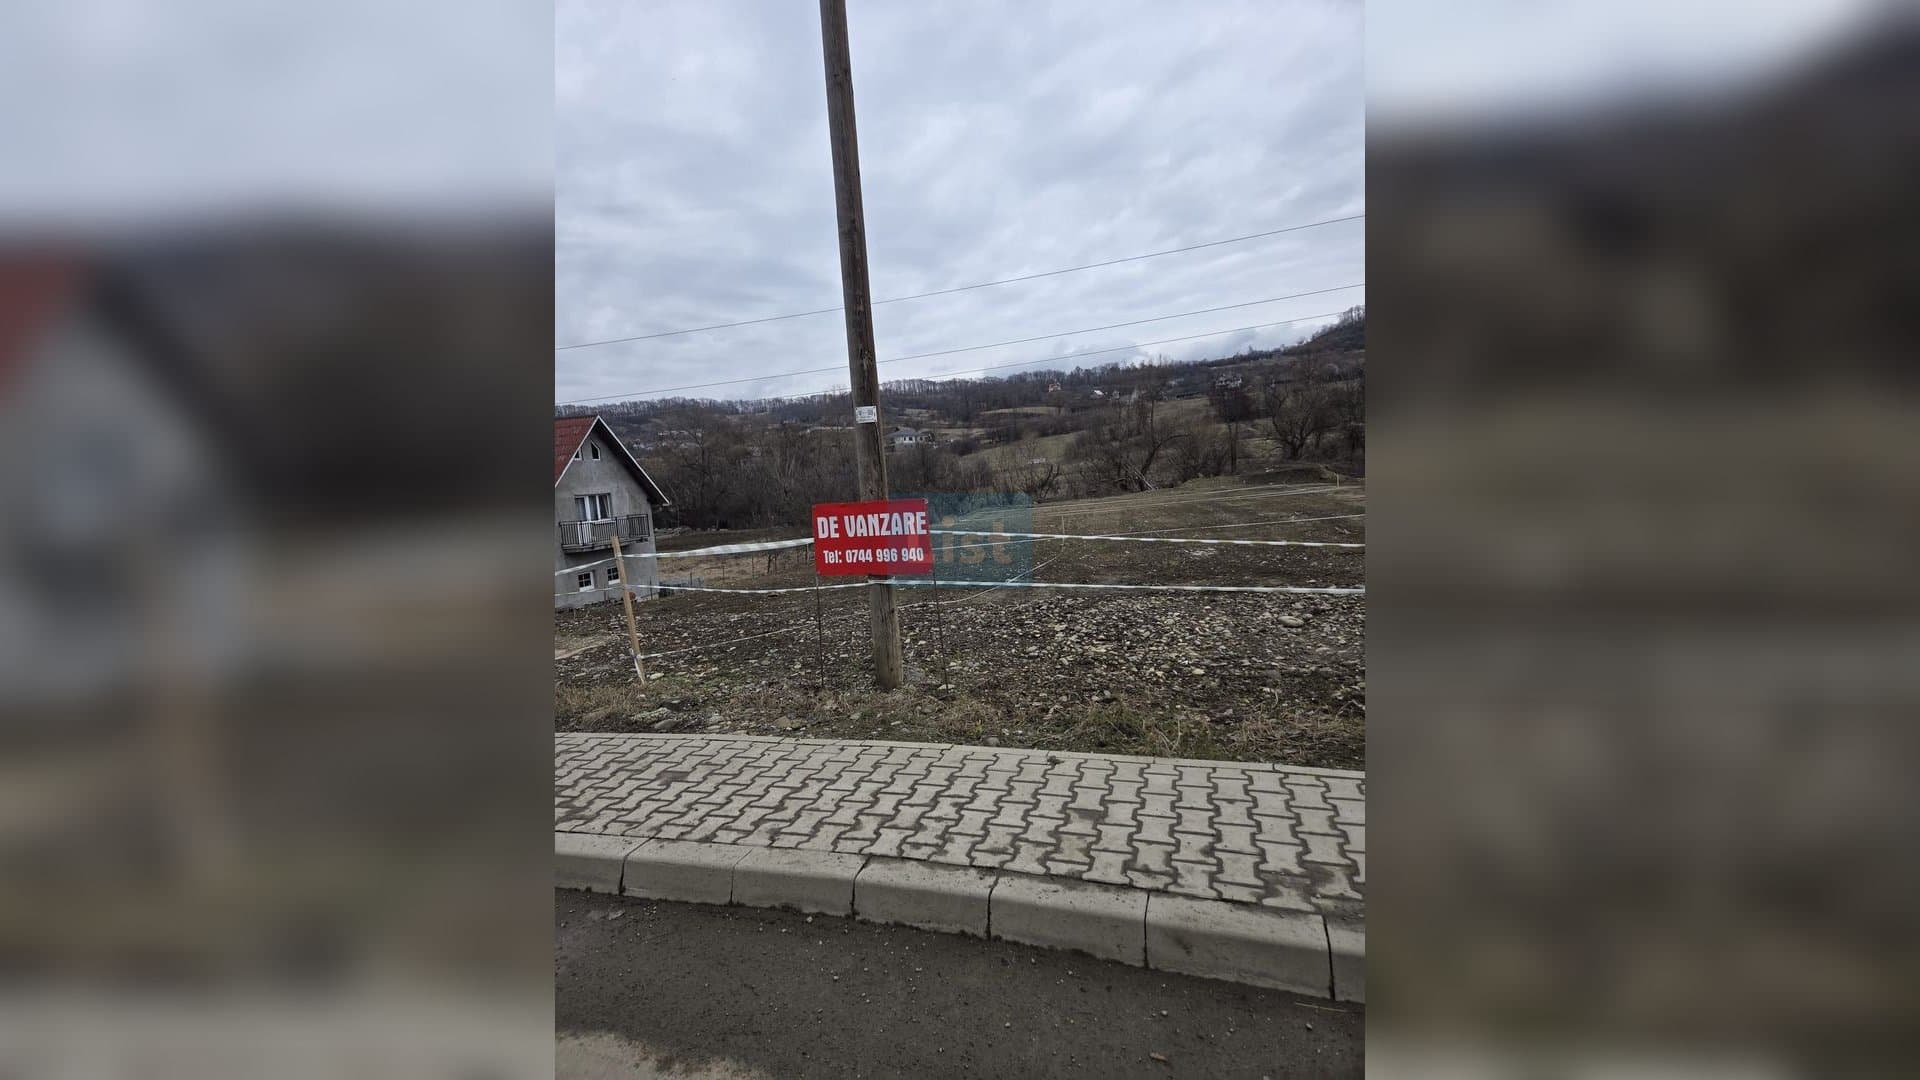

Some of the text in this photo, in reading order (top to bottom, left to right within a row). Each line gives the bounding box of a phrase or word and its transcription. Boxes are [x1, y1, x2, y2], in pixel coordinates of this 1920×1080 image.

[816, 511, 928, 539] DE VANZARE
[823, 547, 924, 564] Tel: 0744 996 940
